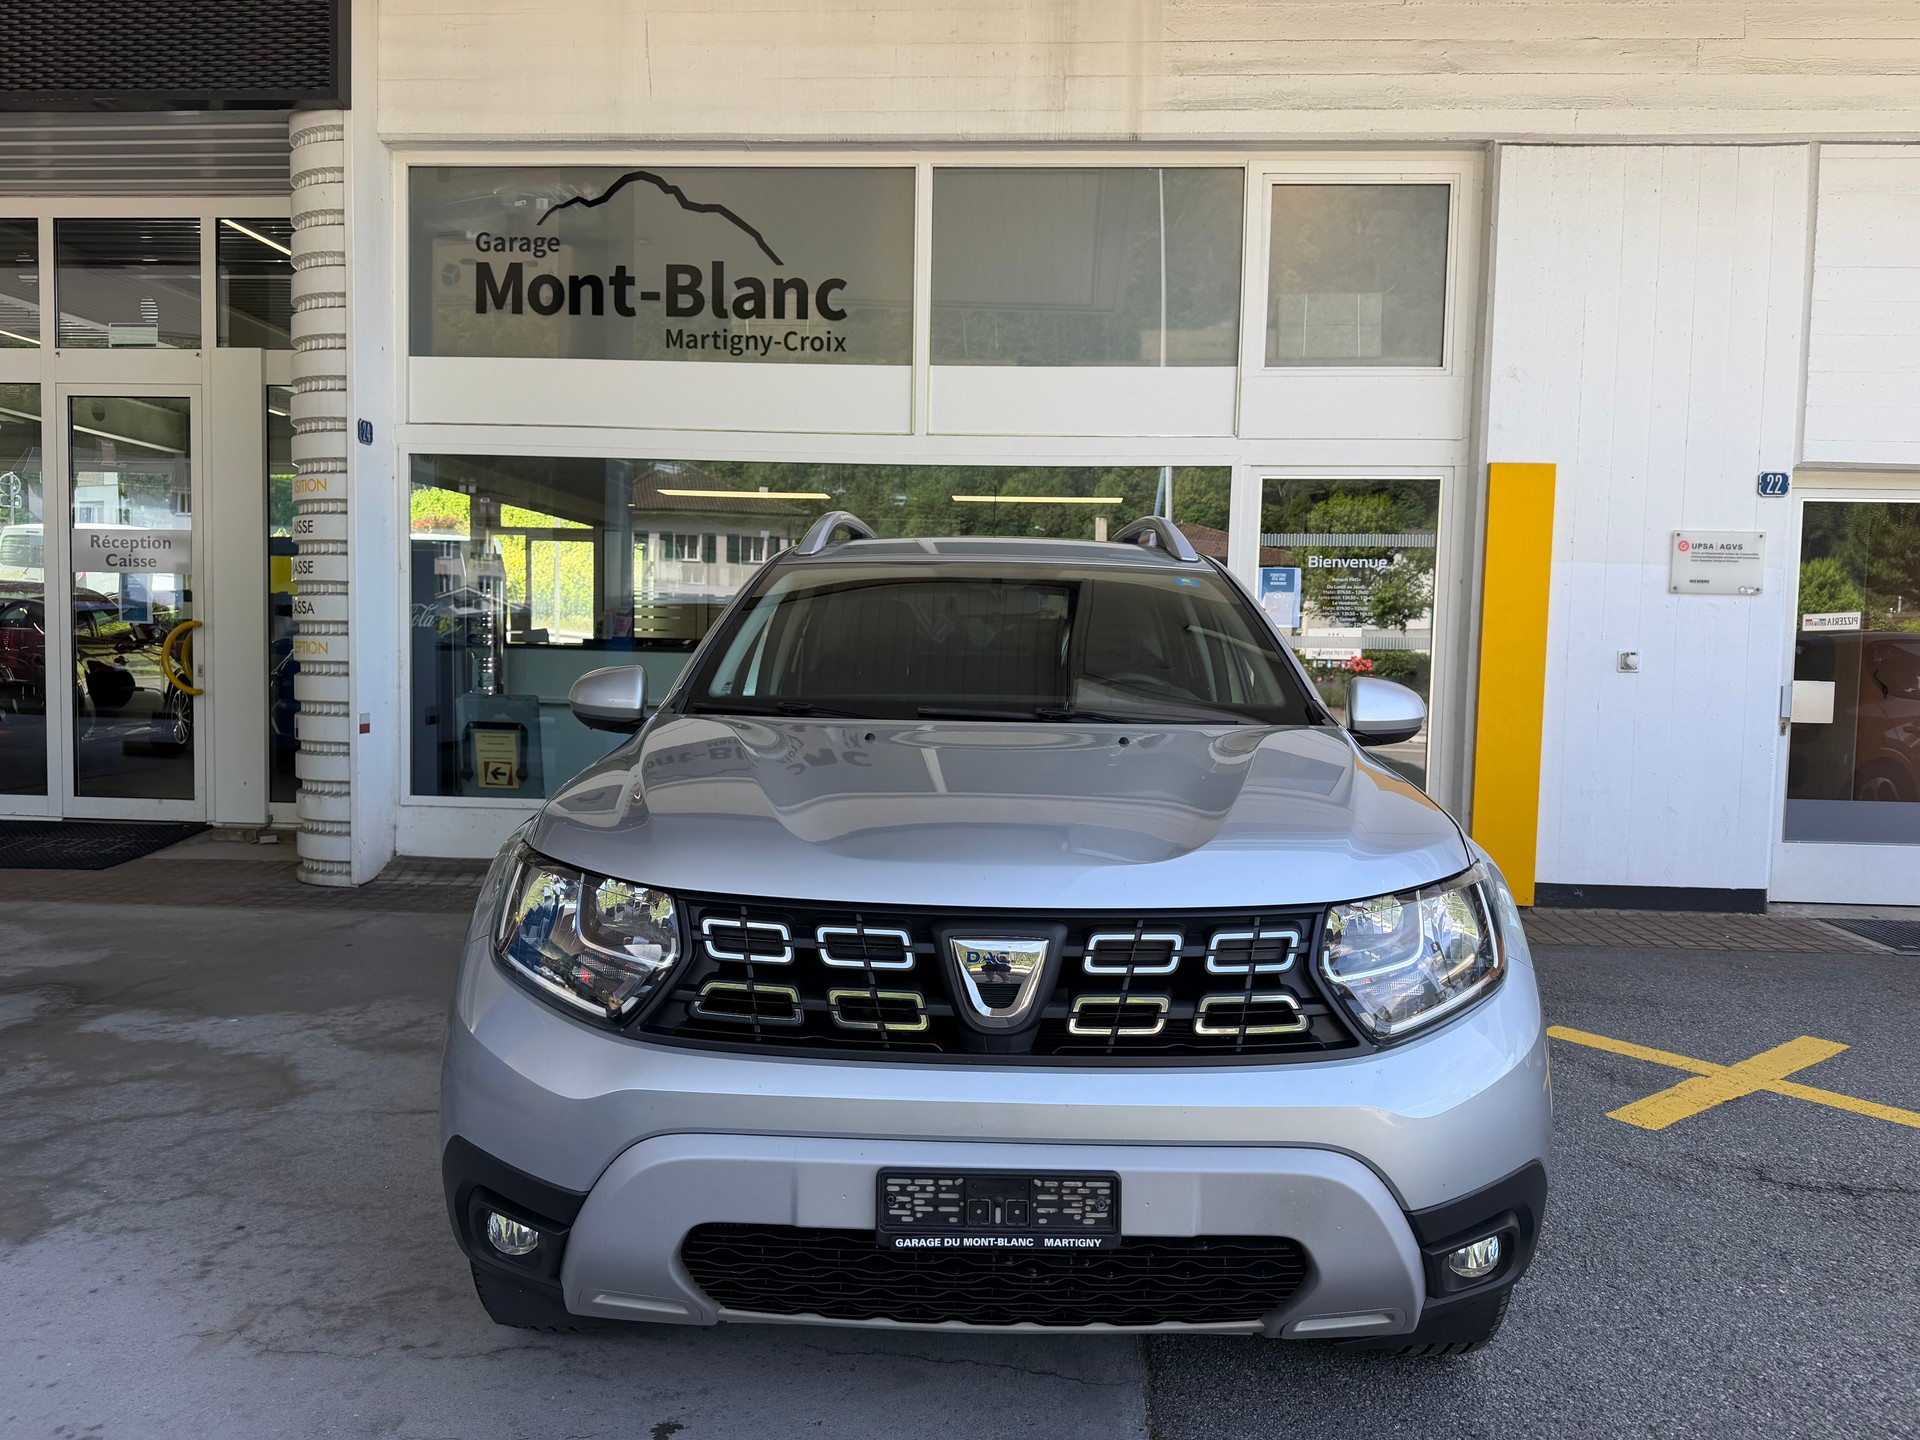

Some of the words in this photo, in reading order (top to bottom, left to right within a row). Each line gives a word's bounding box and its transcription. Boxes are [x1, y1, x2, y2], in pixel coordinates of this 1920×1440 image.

[475, 231, 560, 258] Garage
[475, 260, 848, 321] Mont-Blanc
[665, 328, 847, 356] Martigny-Croix
[293, 478, 328, 494] SITION
[1766, 474, 1782, 494] 22
[90, 534, 172, 553] Réception
[1691, 542, 1714, 550] UPSA
[1719, 543, 1744, 551] AGVS
[105, 553, 158, 568] Caisse
[1308, 555, 1388, 569] Bienvenue
[895, 1238, 941, 1248] GARAGE
[943, 1238, 960, 1247] DU
[963, 1237, 1034, 1247] MONT-BLANC
[1044, 1238, 1102, 1248] MARTIGNY
